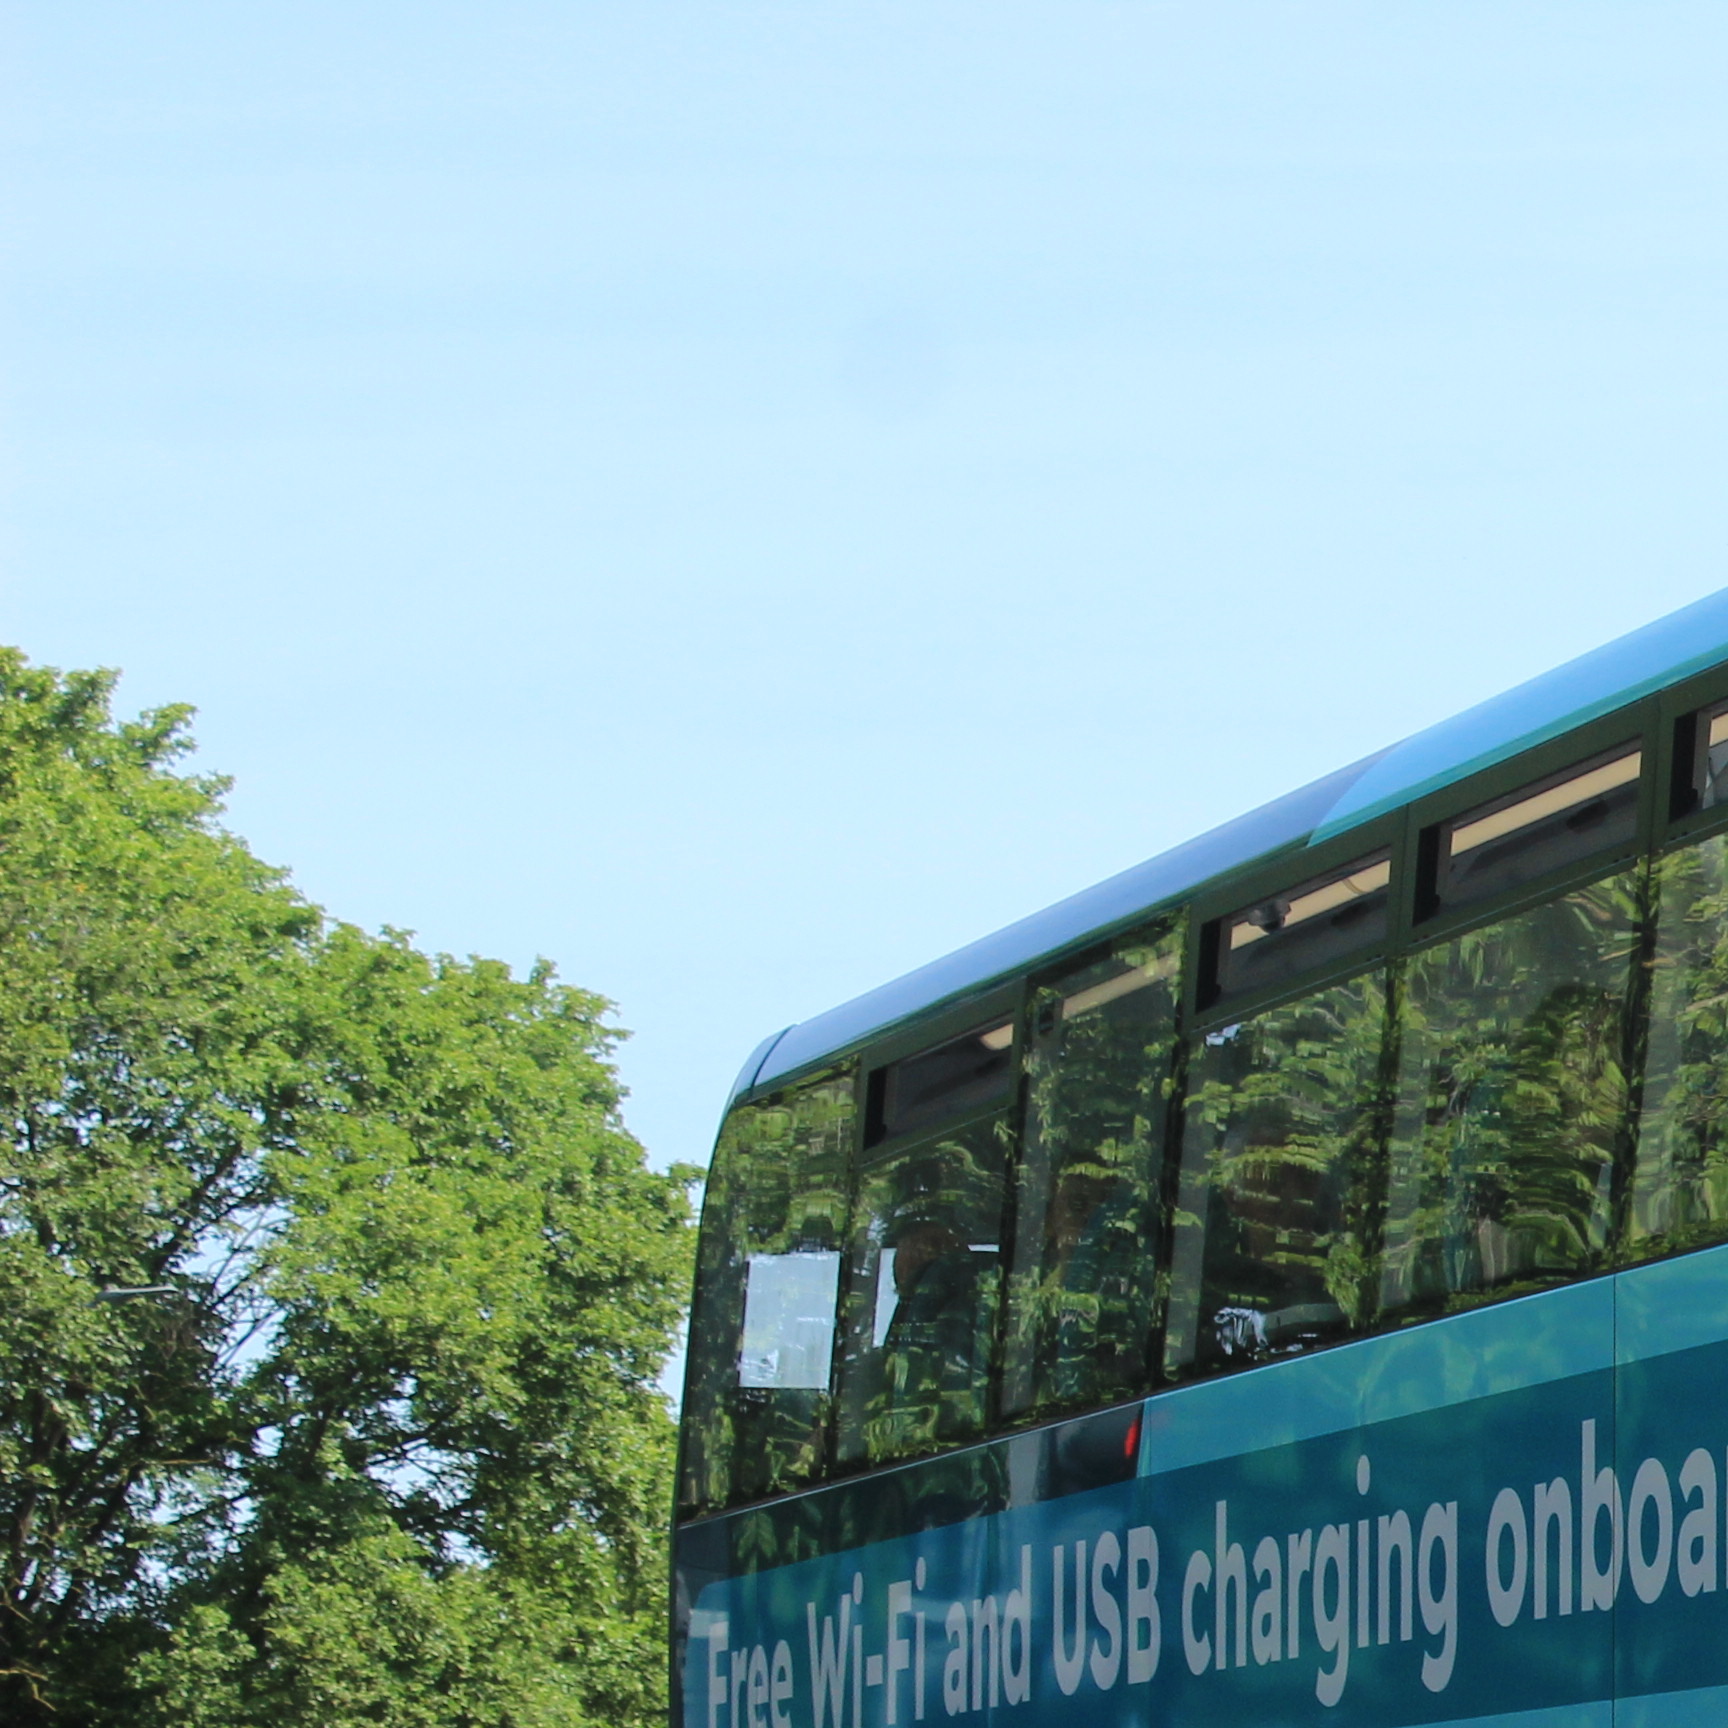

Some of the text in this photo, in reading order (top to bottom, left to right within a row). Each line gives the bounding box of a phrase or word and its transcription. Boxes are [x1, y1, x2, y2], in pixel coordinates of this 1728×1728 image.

[944, 1545, 1030, 1718] and
[1053, 1526, 1160, 1697] USB
[1181, 1455, 1458, 1707] charging
